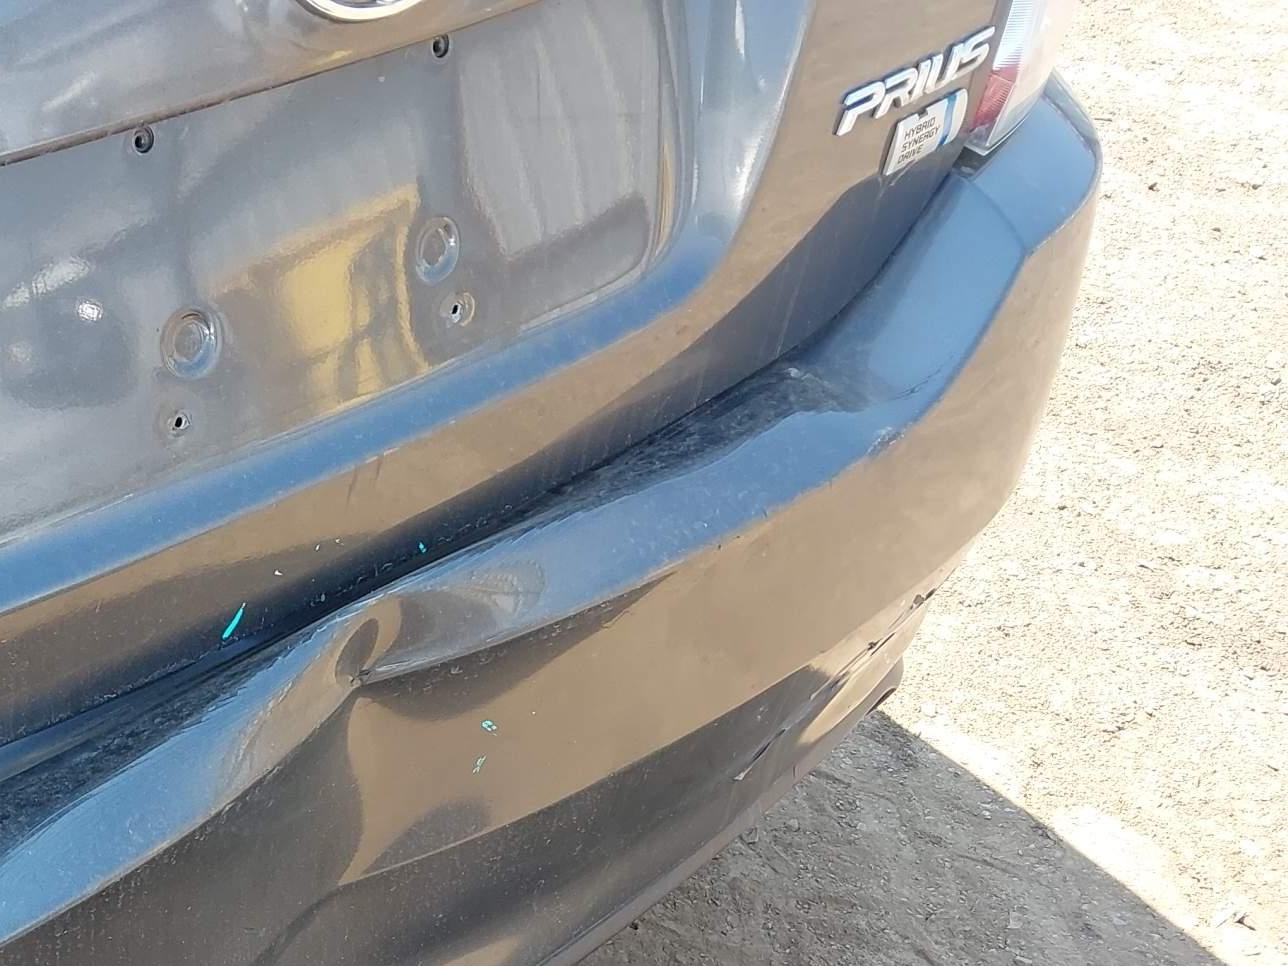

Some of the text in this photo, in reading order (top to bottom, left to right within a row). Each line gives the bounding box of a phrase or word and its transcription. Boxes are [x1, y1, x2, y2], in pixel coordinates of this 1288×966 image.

[833, 25, 995, 137] PRIUS
[901, 127, 940, 152] SYNERGY
[904, 116, 936, 140] HYBRID
[897, 144, 924, 164] DRIVE
